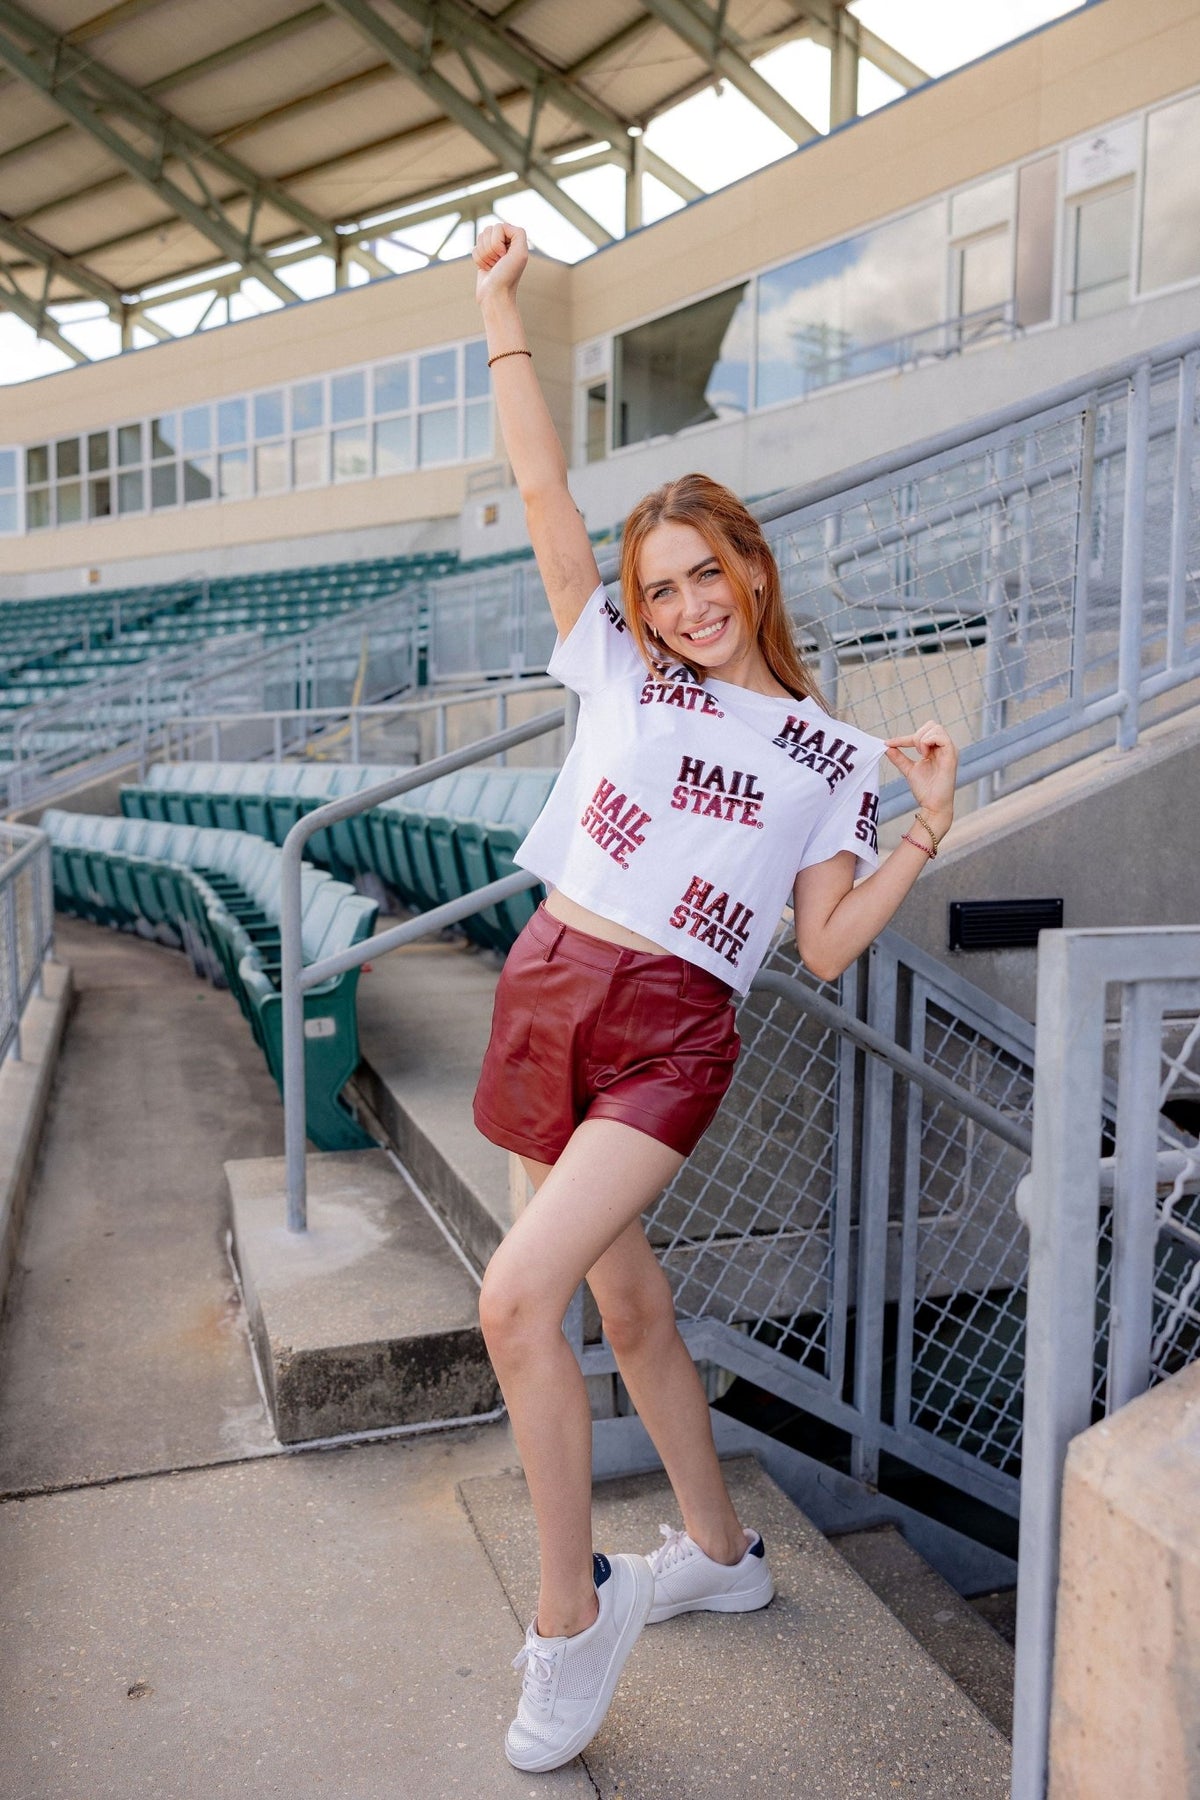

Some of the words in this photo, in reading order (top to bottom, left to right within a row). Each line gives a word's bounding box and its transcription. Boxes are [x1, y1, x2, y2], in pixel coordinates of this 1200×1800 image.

[778, 715, 858, 773] HAIL
[677, 755, 765, 801] HAIL
[592, 776, 652, 846] HAIL
[681, 875, 755, 942] HAIL
